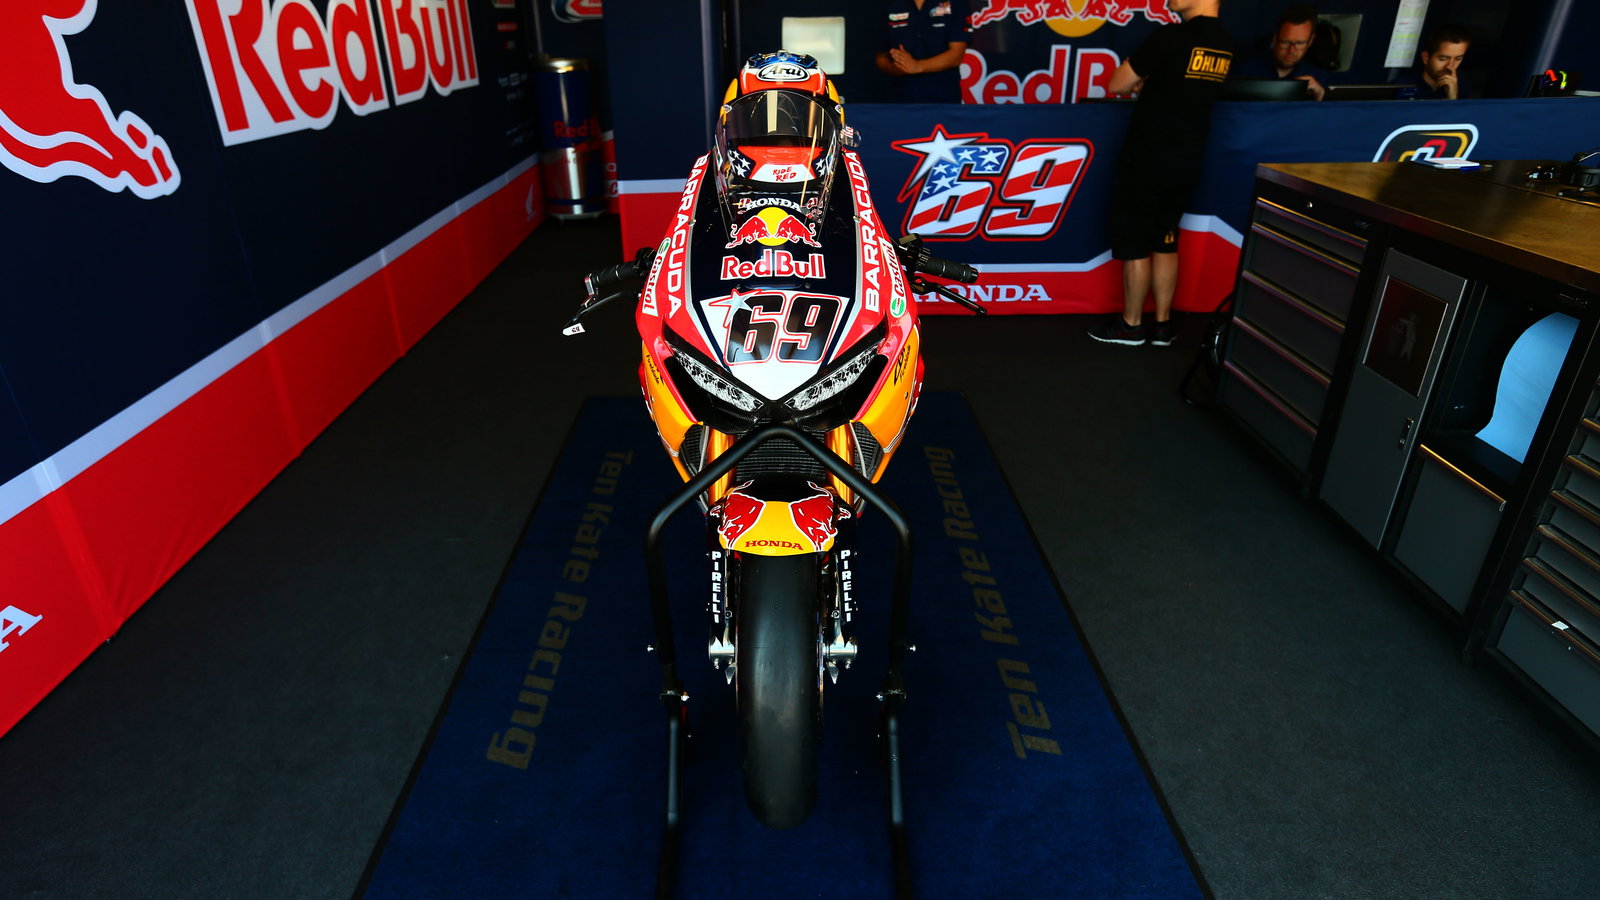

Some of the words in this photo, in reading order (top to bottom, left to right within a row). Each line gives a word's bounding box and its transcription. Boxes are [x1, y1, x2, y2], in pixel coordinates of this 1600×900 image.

[192, 0, 387, 133] Red
[761, 65, 801, 77] Arai
[960, 46, 1070, 104] Red
[746, 197, 802, 213] HONDA
[772, 166, 792, 175] RIDE
[775, 172, 797, 181] RED
[901, 137, 1095, 242] 69
[667, 153, 709, 320] BARRACUDA
[721, 249, 773, 280] Red
[774, 250, 826, 279] Bull
[844, 151, 881, 313] BARRACUDA
[643, 256, 663, 310] Castrol
[883, 241, 905, 298] Castrol
[722, 290, 842, 366] 69
[592, 449, 634, 496] Ten
[923, 445, 980, 541] Racing
[562, 502, 614, 583] Kate
[744, 540, 803, 551] HONDA
[711, 550, 722, 624] PIRELLI
[840, 549, 852, 623] PIRELLI
[959, 547, 1020, 647] Kate
[486, 592, 588, 770] Racing
[996, 658, 1063, 760] Ten
